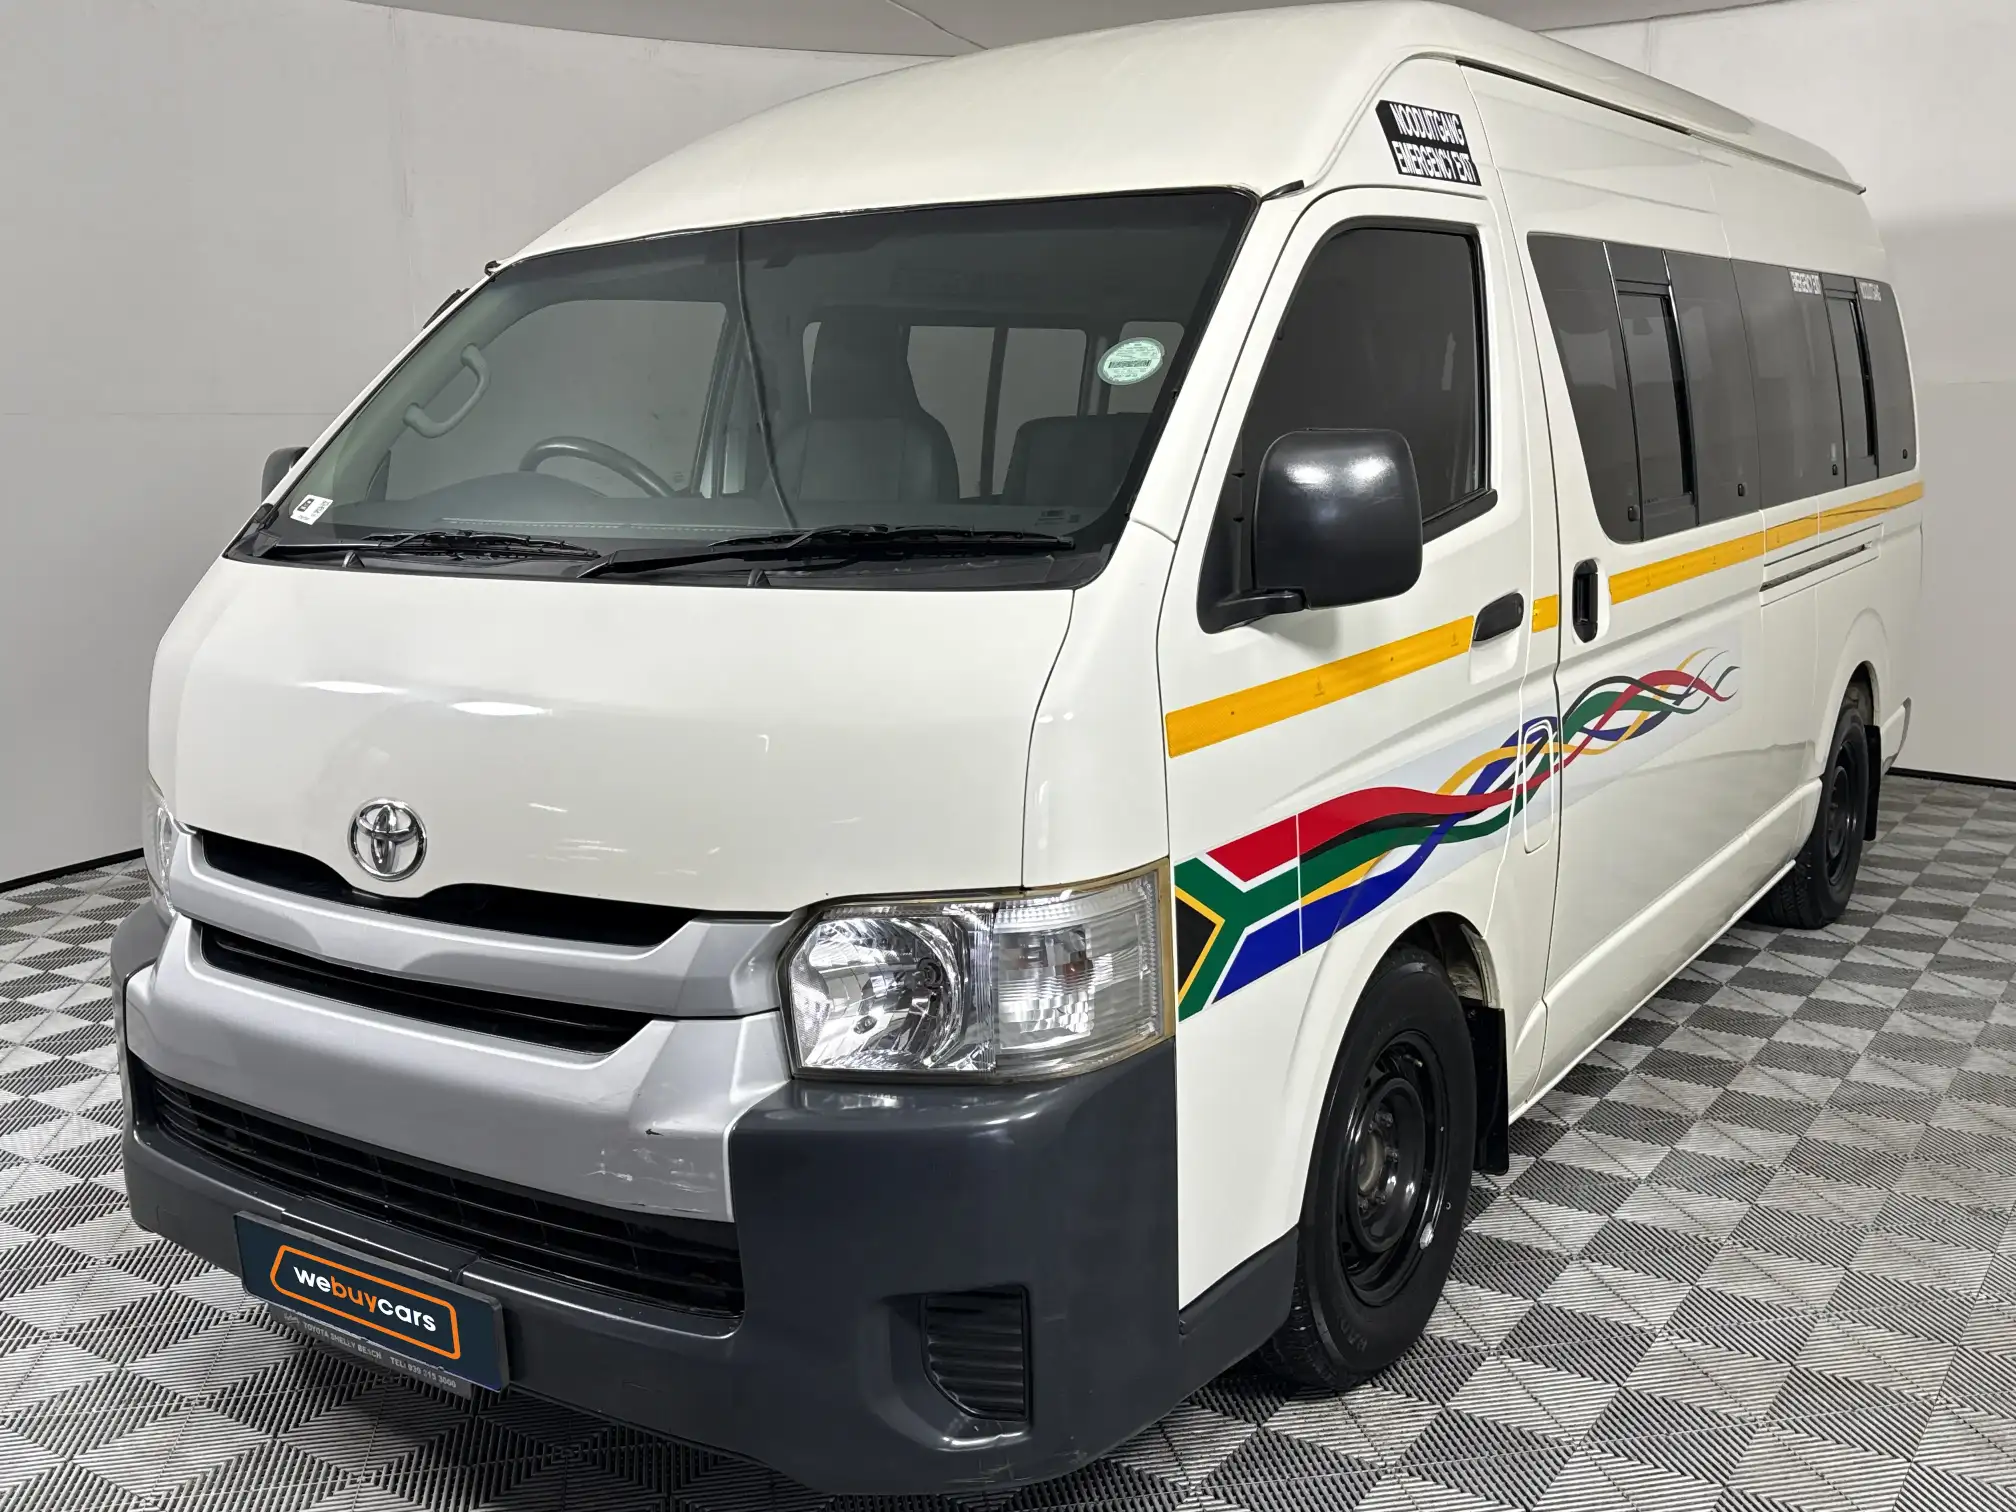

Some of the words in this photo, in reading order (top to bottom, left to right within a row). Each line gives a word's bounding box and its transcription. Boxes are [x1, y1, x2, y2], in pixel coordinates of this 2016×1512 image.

[1389, 103, 1465, 146] NOODUITGANG
[1391, 141, 1457, 180] EMERGENCY
[1450, 150, 1477, 183] EXIT
[293, 1266, 437, 1332] webuycars
[303, 1321, 330, 1338] TOYOTA
[330, 1333, 356, 1348] SHELLY
